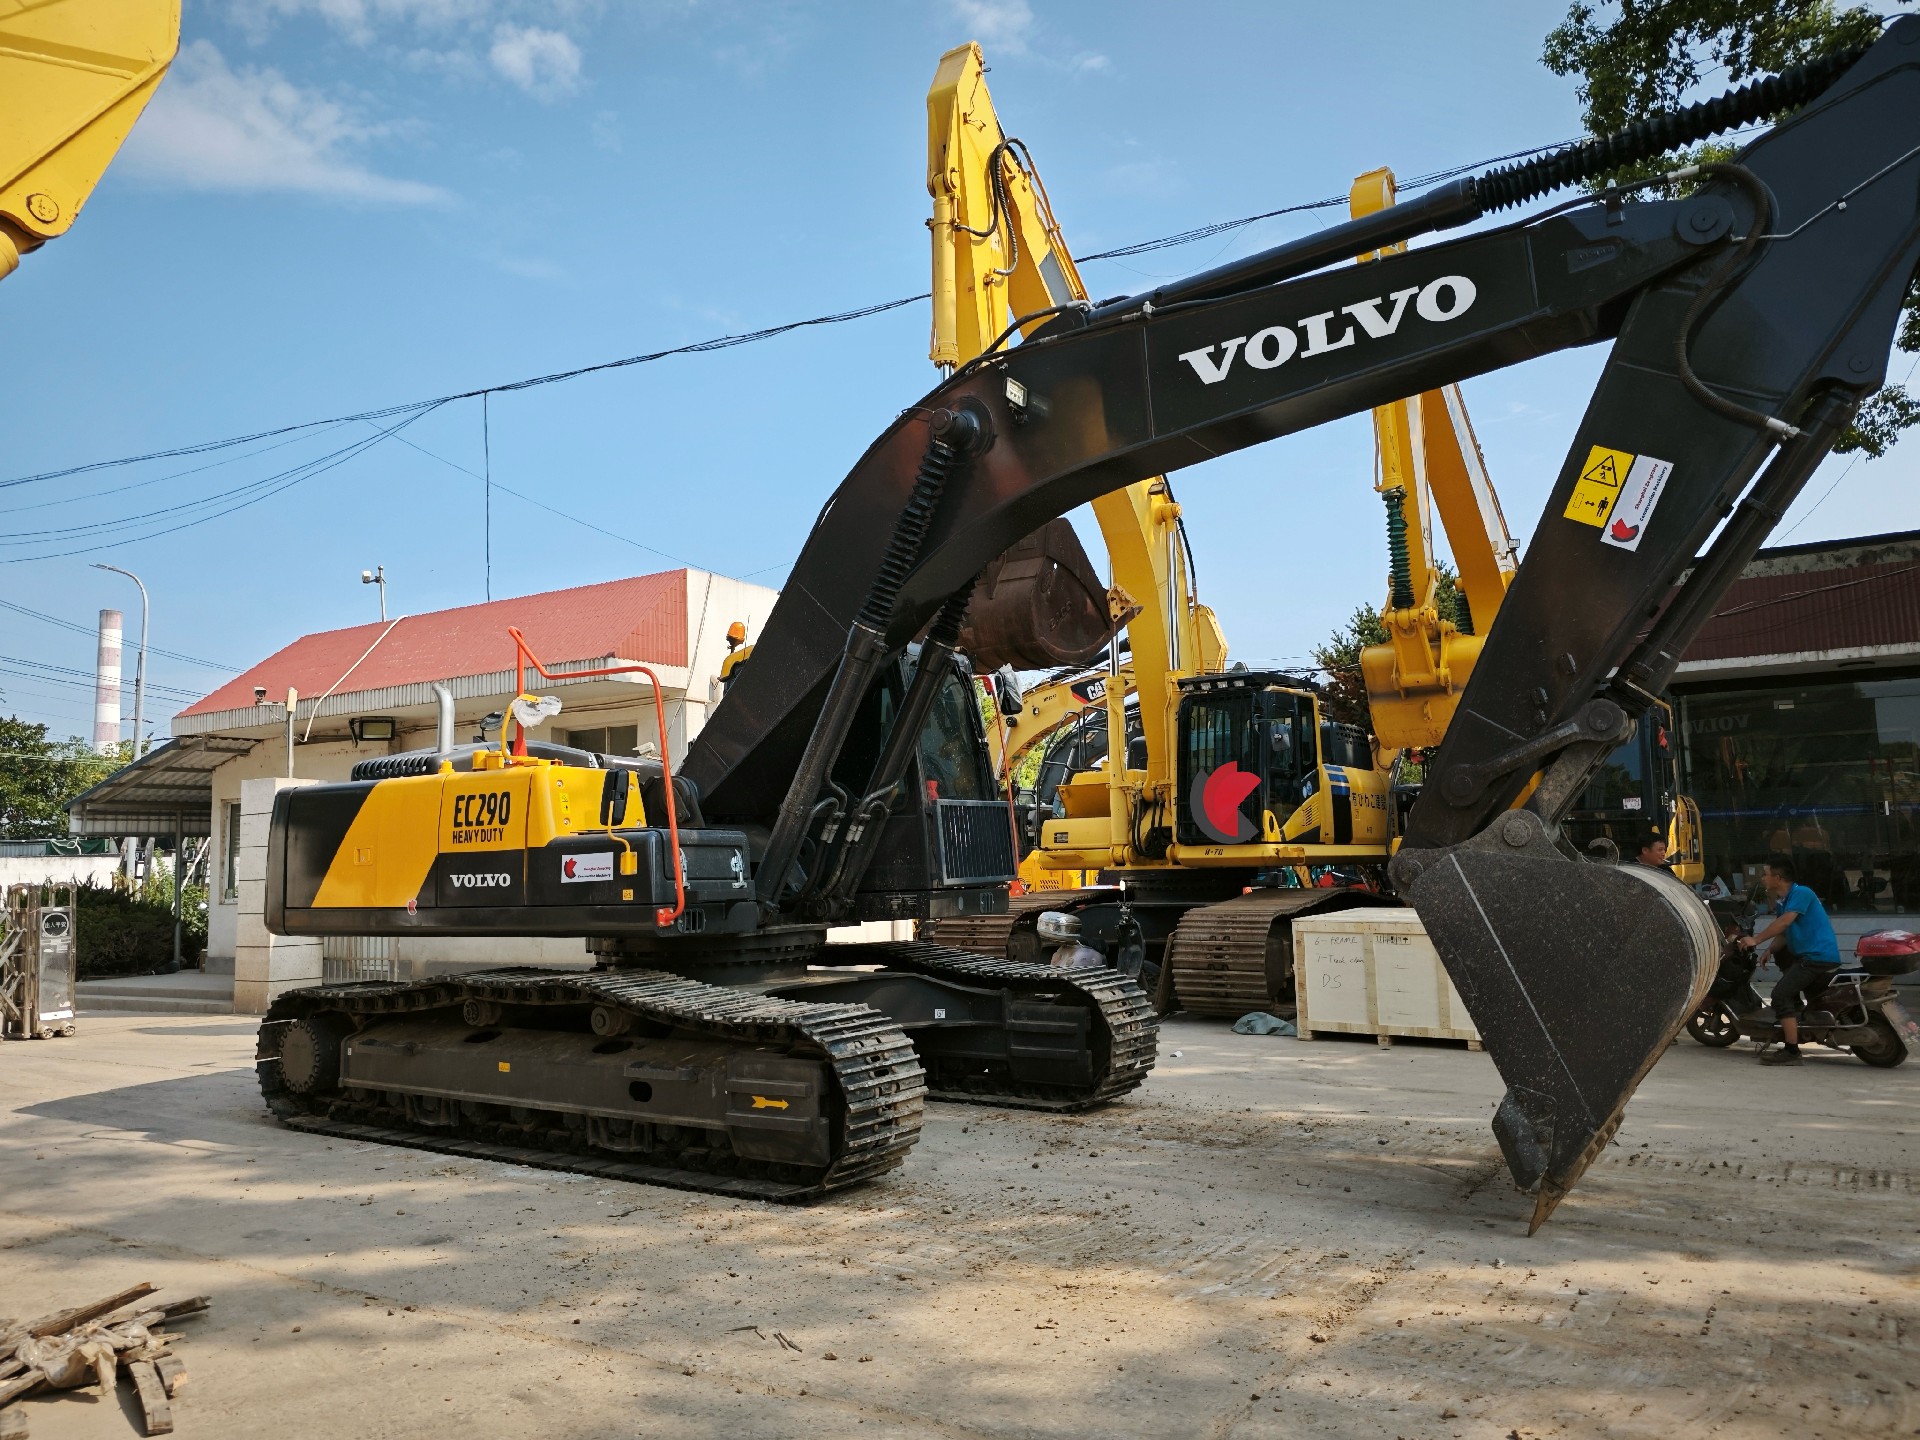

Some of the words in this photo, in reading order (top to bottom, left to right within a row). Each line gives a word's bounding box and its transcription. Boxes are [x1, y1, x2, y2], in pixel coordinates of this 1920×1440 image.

[1178, 275, 1477, 385] VOLVO
[453, 791, 511, 828] EC290
[453, 828, 480, 844] HEAVY
[480, 827, 505, 843] DUTY
[450, 873, 511, 888] VOLVO
